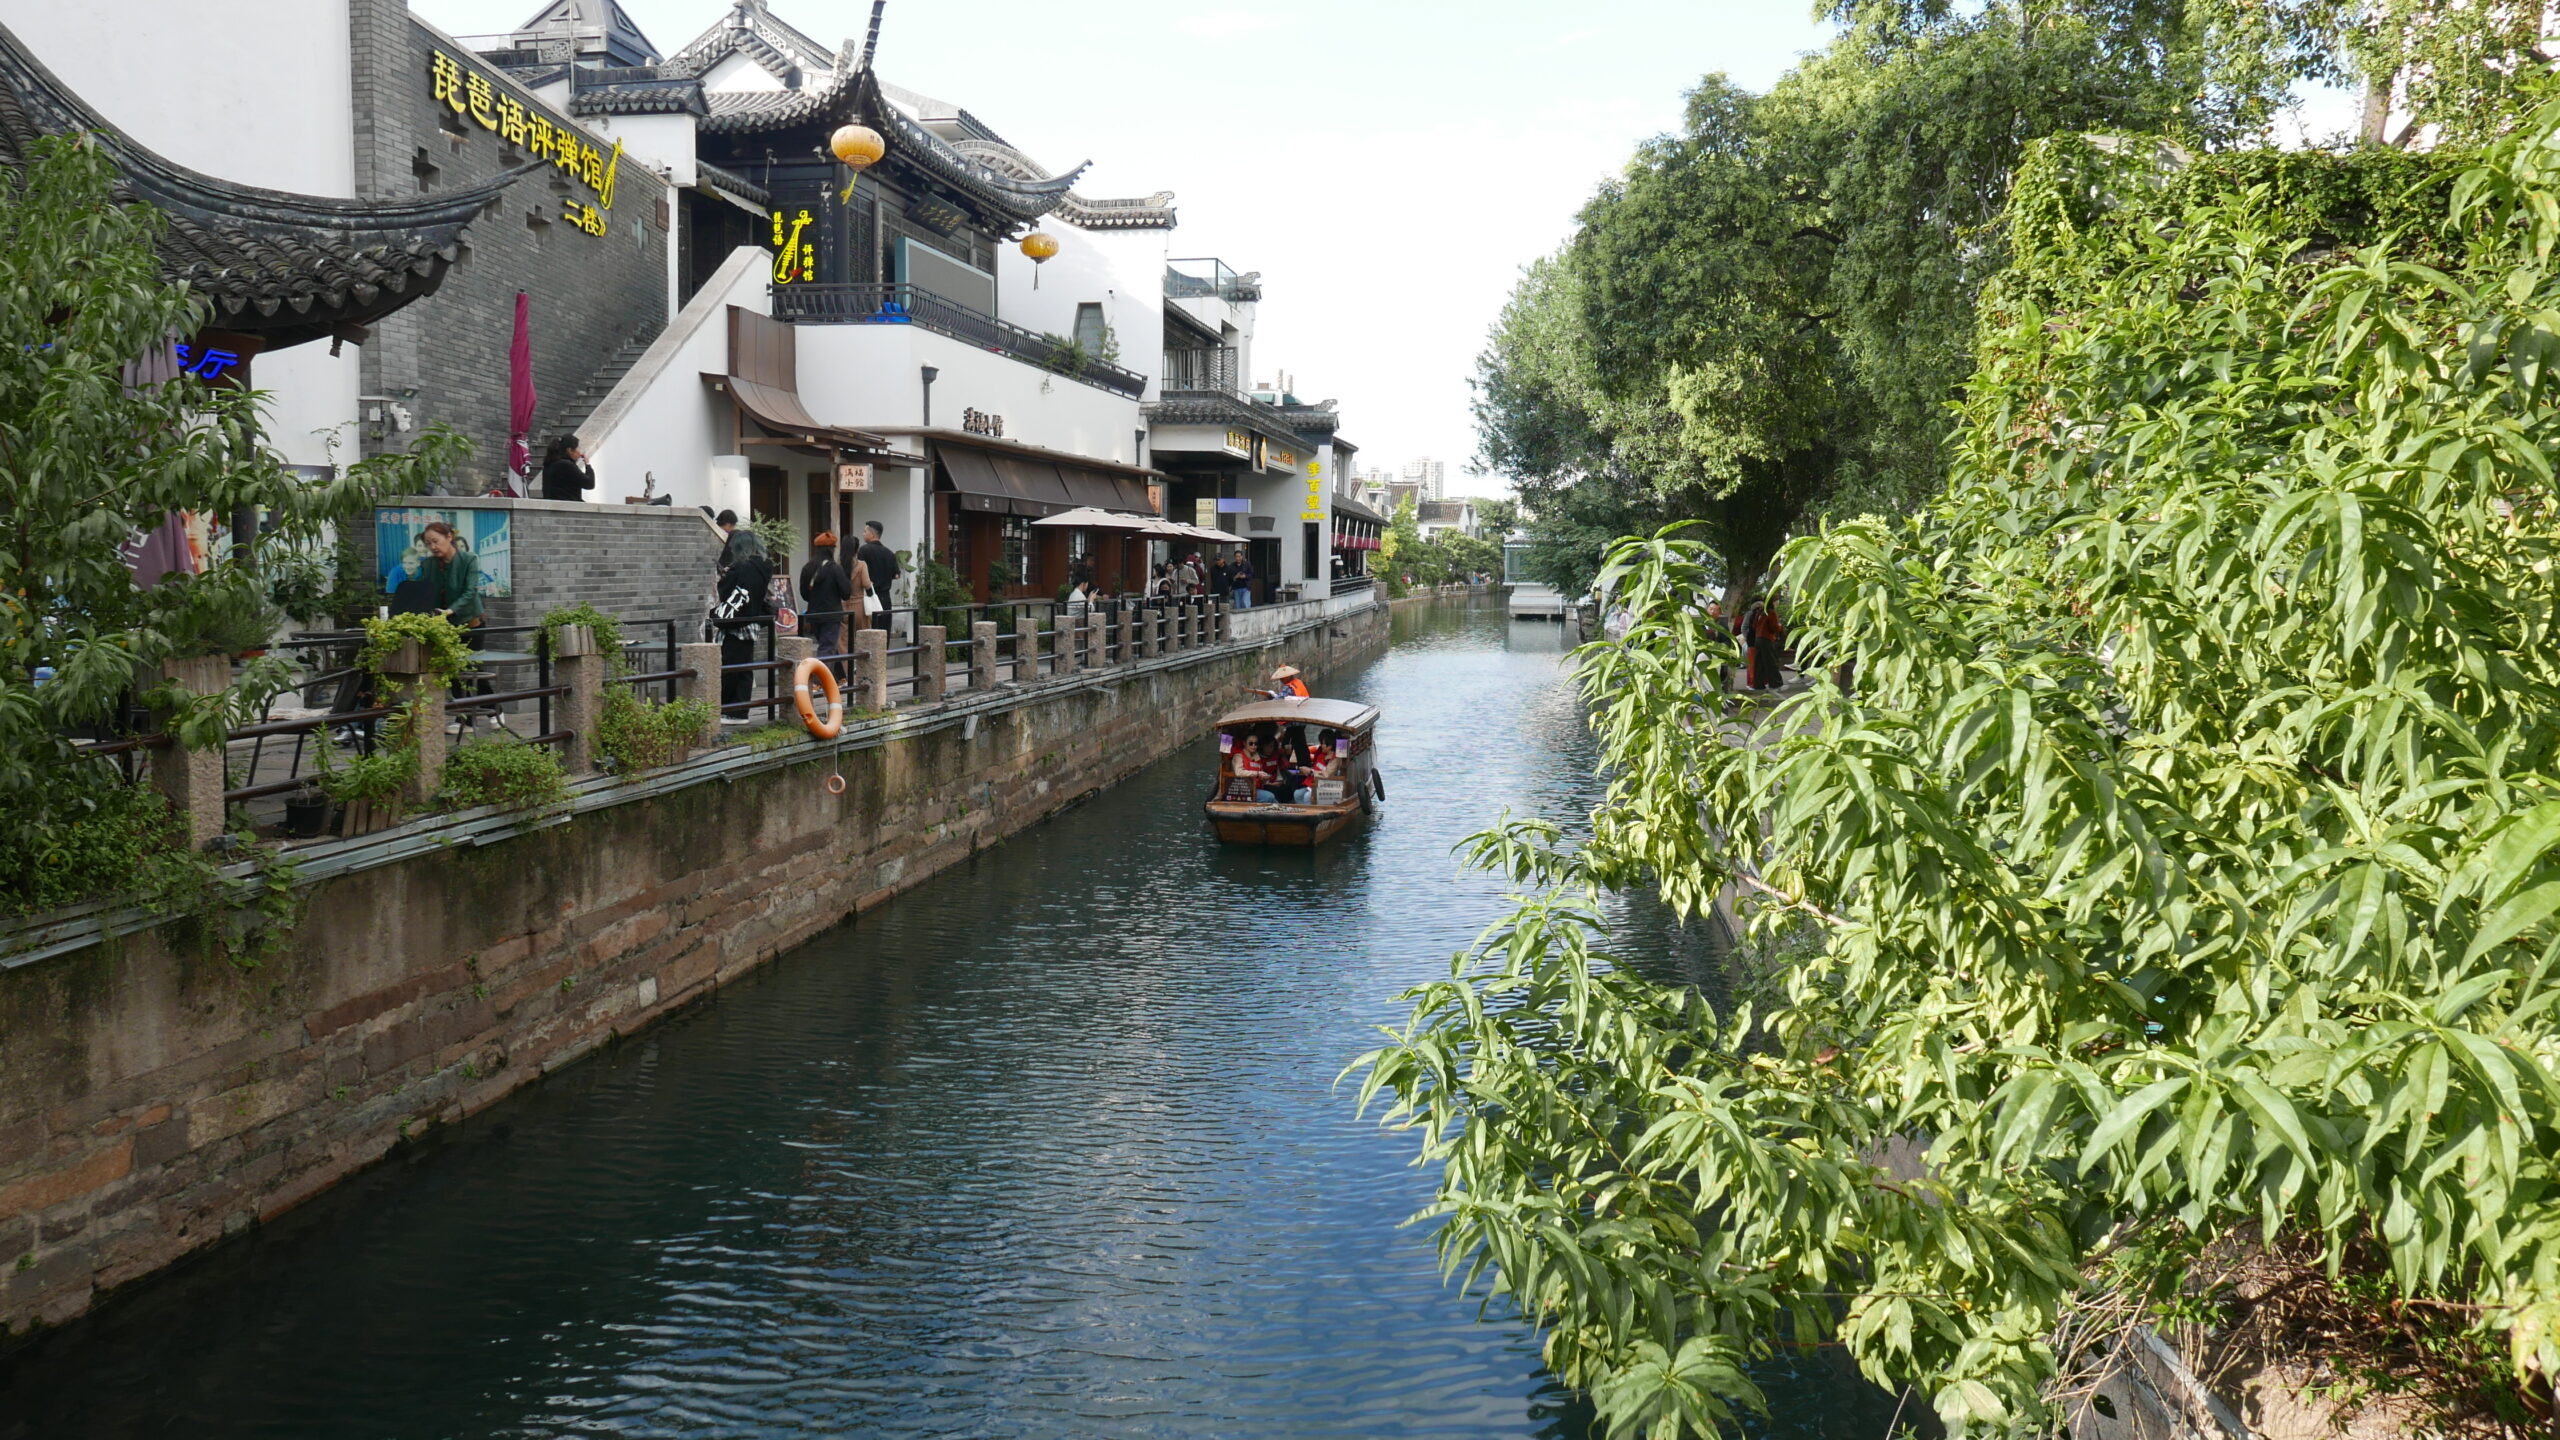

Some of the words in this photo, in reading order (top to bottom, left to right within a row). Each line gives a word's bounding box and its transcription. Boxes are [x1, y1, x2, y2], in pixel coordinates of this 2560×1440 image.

[432, 49, 603, 192] 琵琶语评弹馆
[564, 200, 602, 236] 二楼
